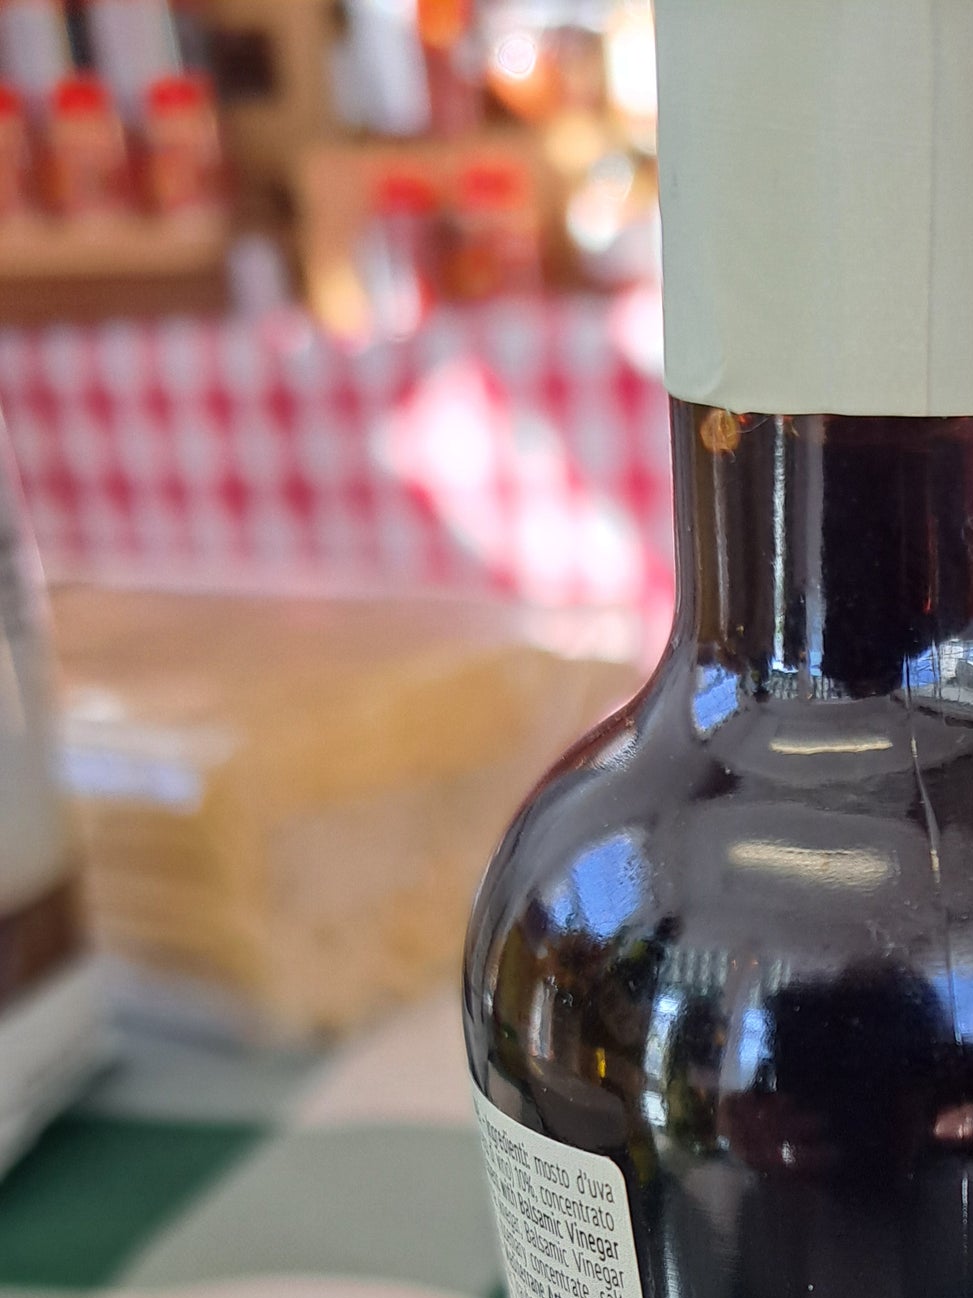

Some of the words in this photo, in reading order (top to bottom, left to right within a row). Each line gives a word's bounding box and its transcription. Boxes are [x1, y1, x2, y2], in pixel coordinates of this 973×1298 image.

[533, 1155, 570, 1189] mosto
[576, 1168, 615, 1204] d'uva
[539, 1186, 615, 1232] concentrato
[517, 1191, 564, 1239] Balsamic
[565, 1219, 619, 1262] Vinegar
[524, 1221, 569, 1268] Balsamic
[572, 1248, 625, 1292] Vinegar
